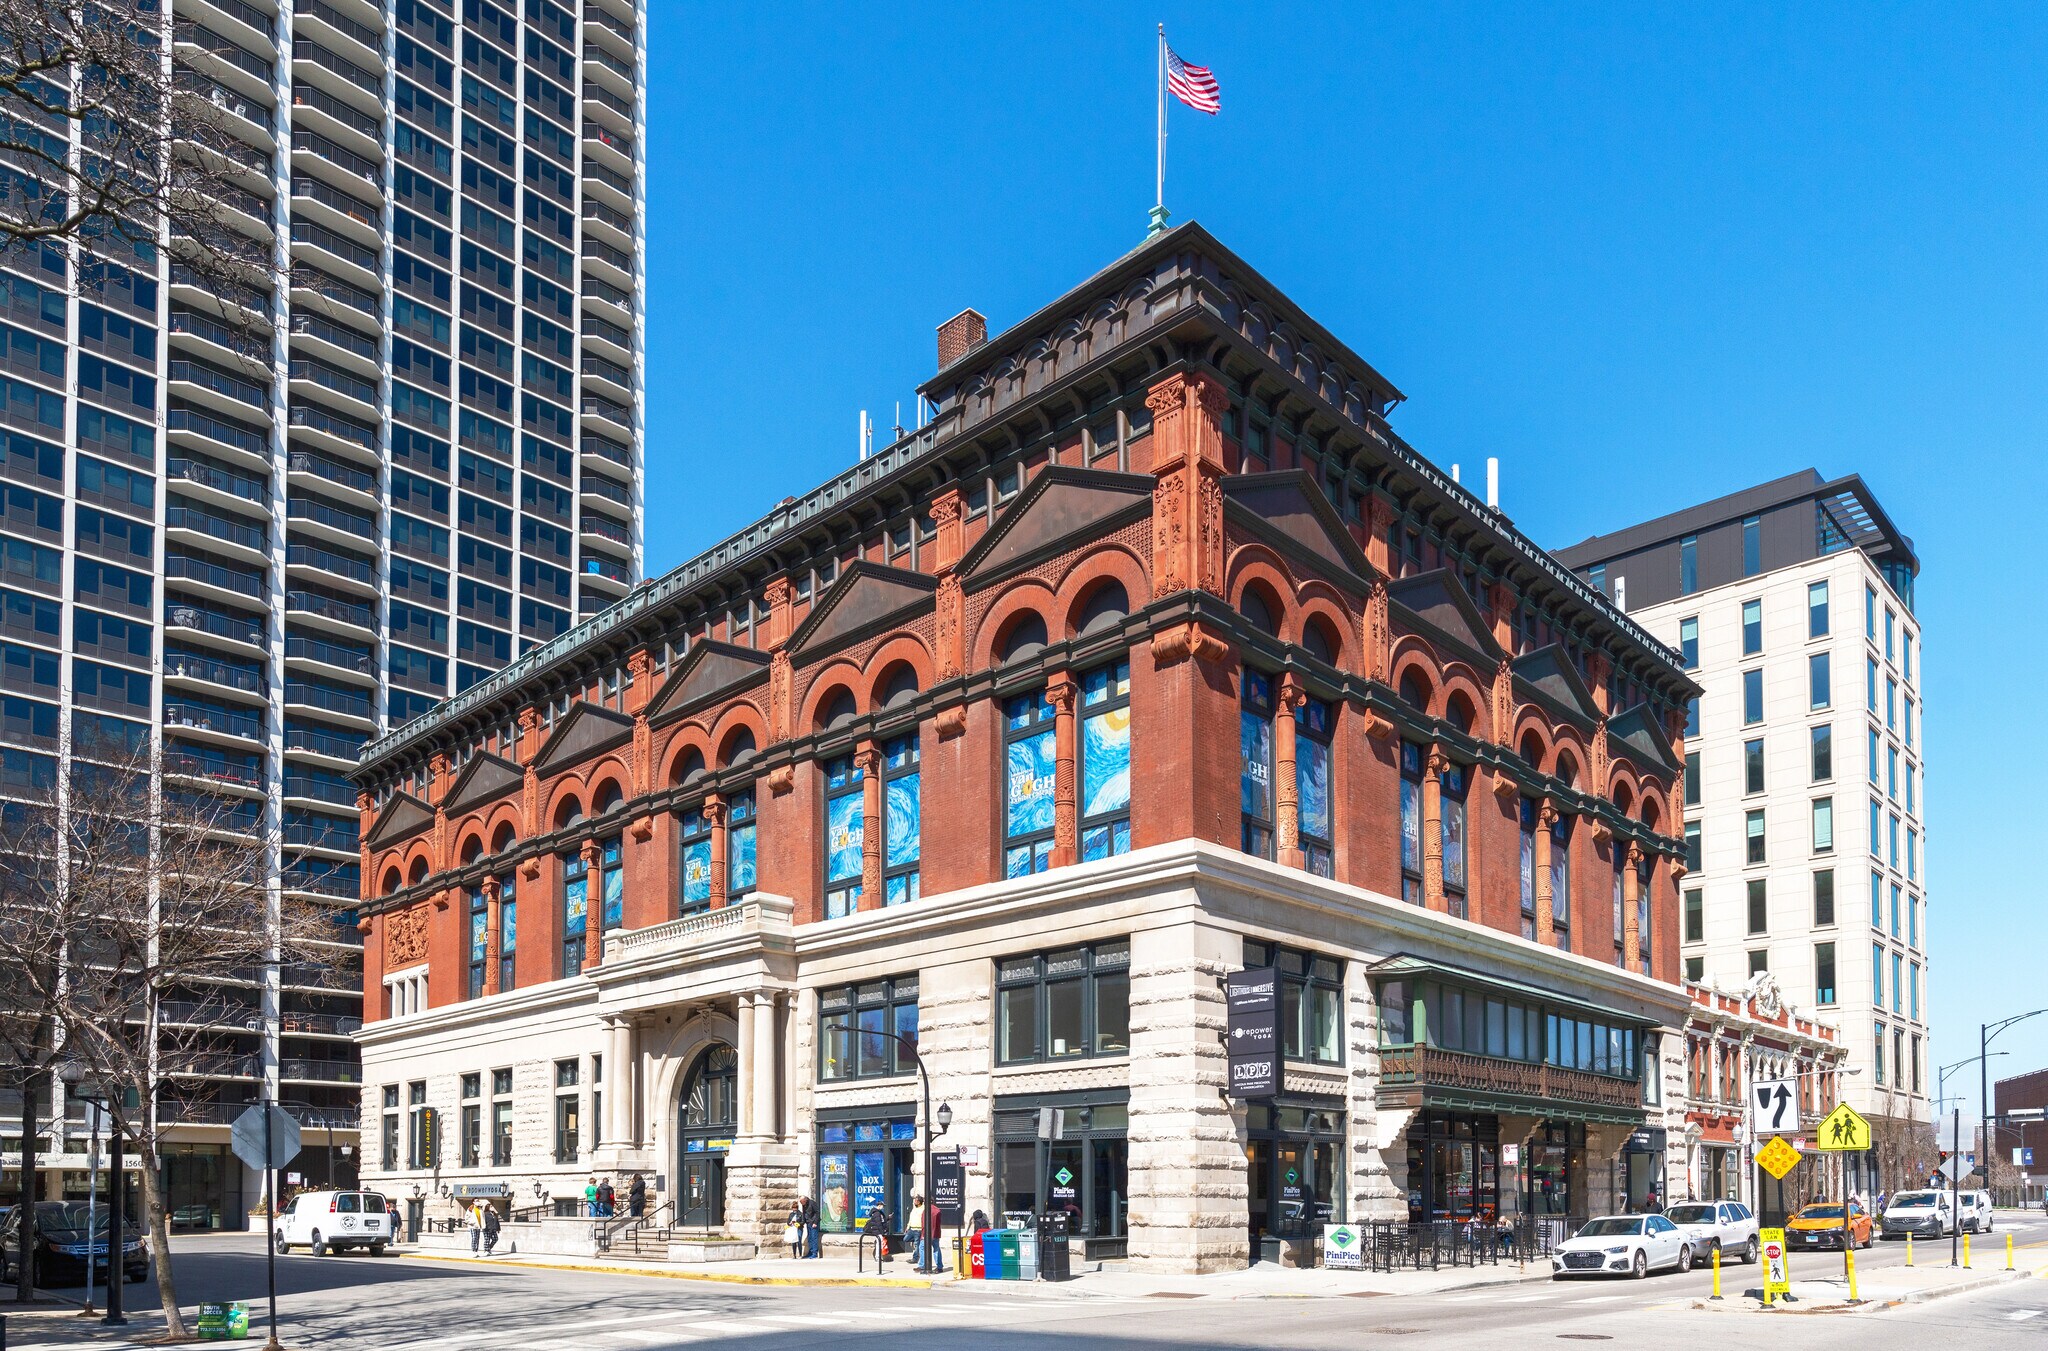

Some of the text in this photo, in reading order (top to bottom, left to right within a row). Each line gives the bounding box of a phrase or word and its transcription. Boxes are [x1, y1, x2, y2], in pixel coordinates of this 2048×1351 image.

[862, 1176, 880, 1184] BOX
[937, 1178, 958, 1186] WE'VE
[857, 1186, 884, 1194] OFFICE
[1325, 1250, 1360, 1260] PiniPico
